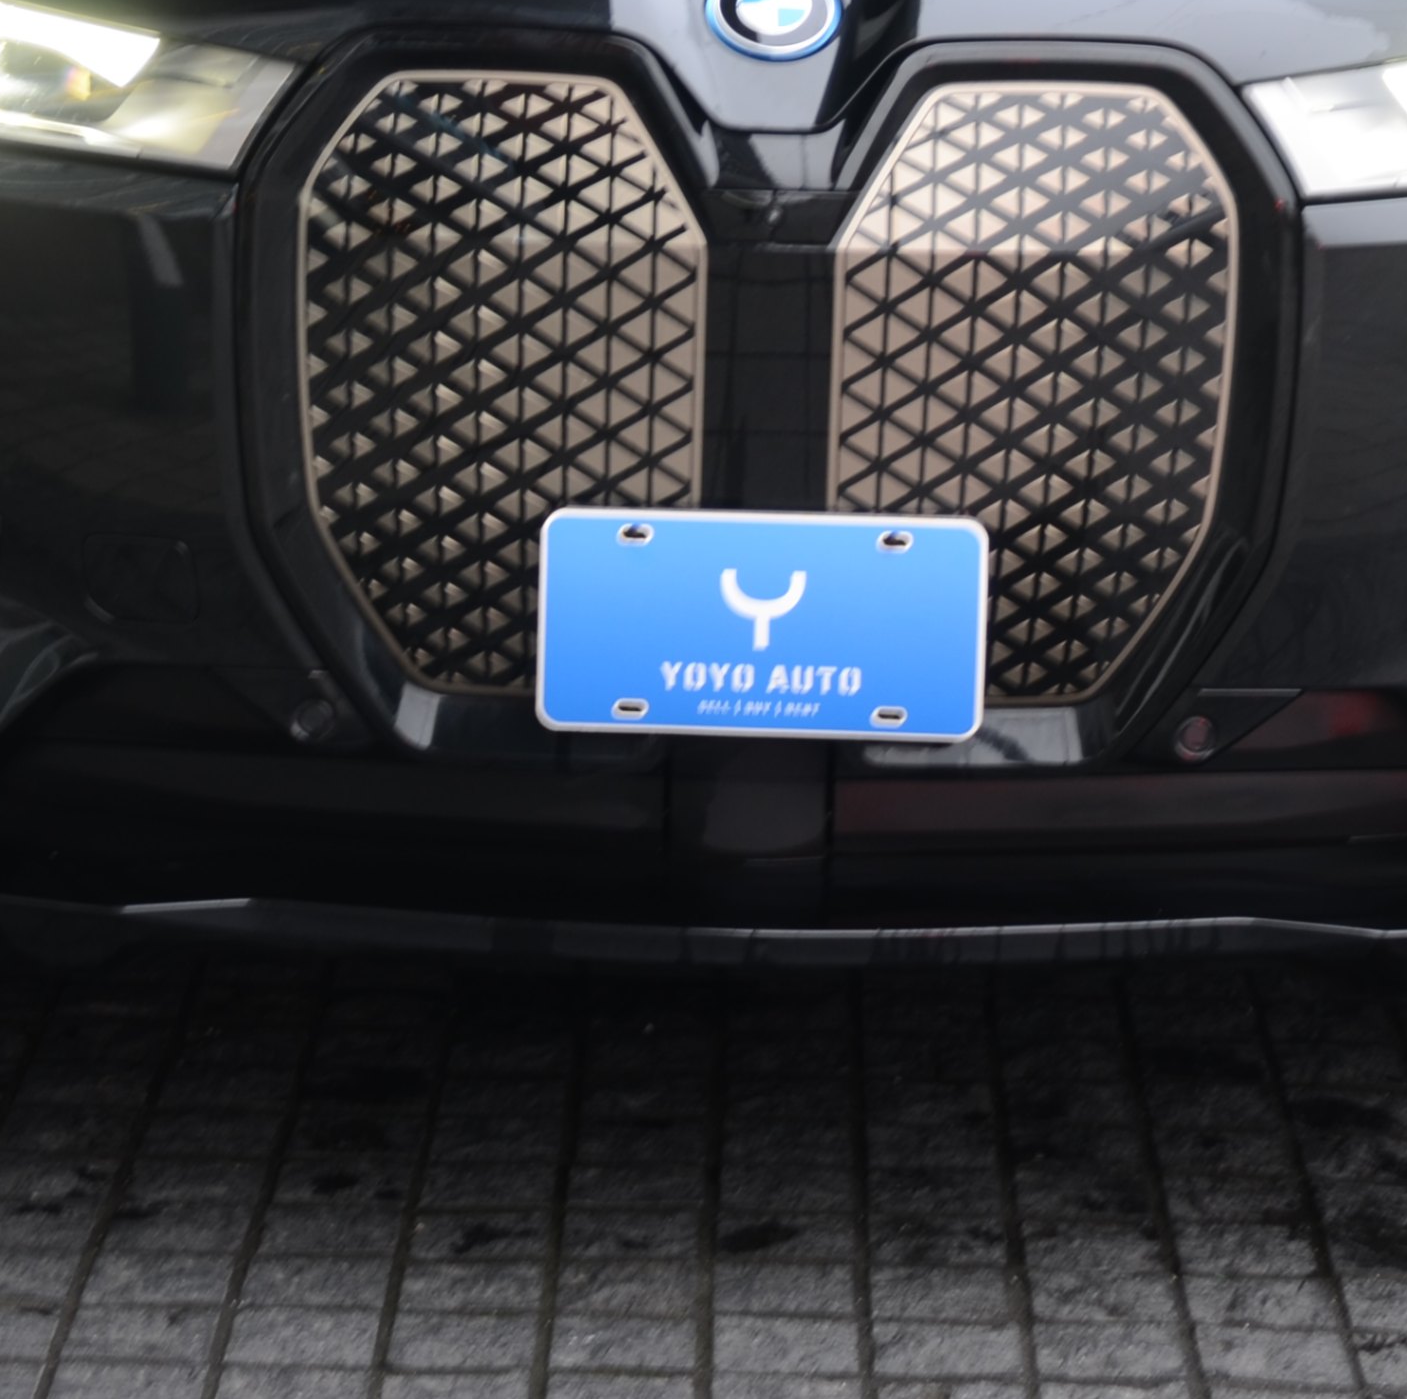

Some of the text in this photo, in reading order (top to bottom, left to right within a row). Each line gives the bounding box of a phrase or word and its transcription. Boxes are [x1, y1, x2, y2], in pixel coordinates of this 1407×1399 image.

[660, 661, 862, 696] YOYO AUTO
[743, 700, 772, 716] BUY
